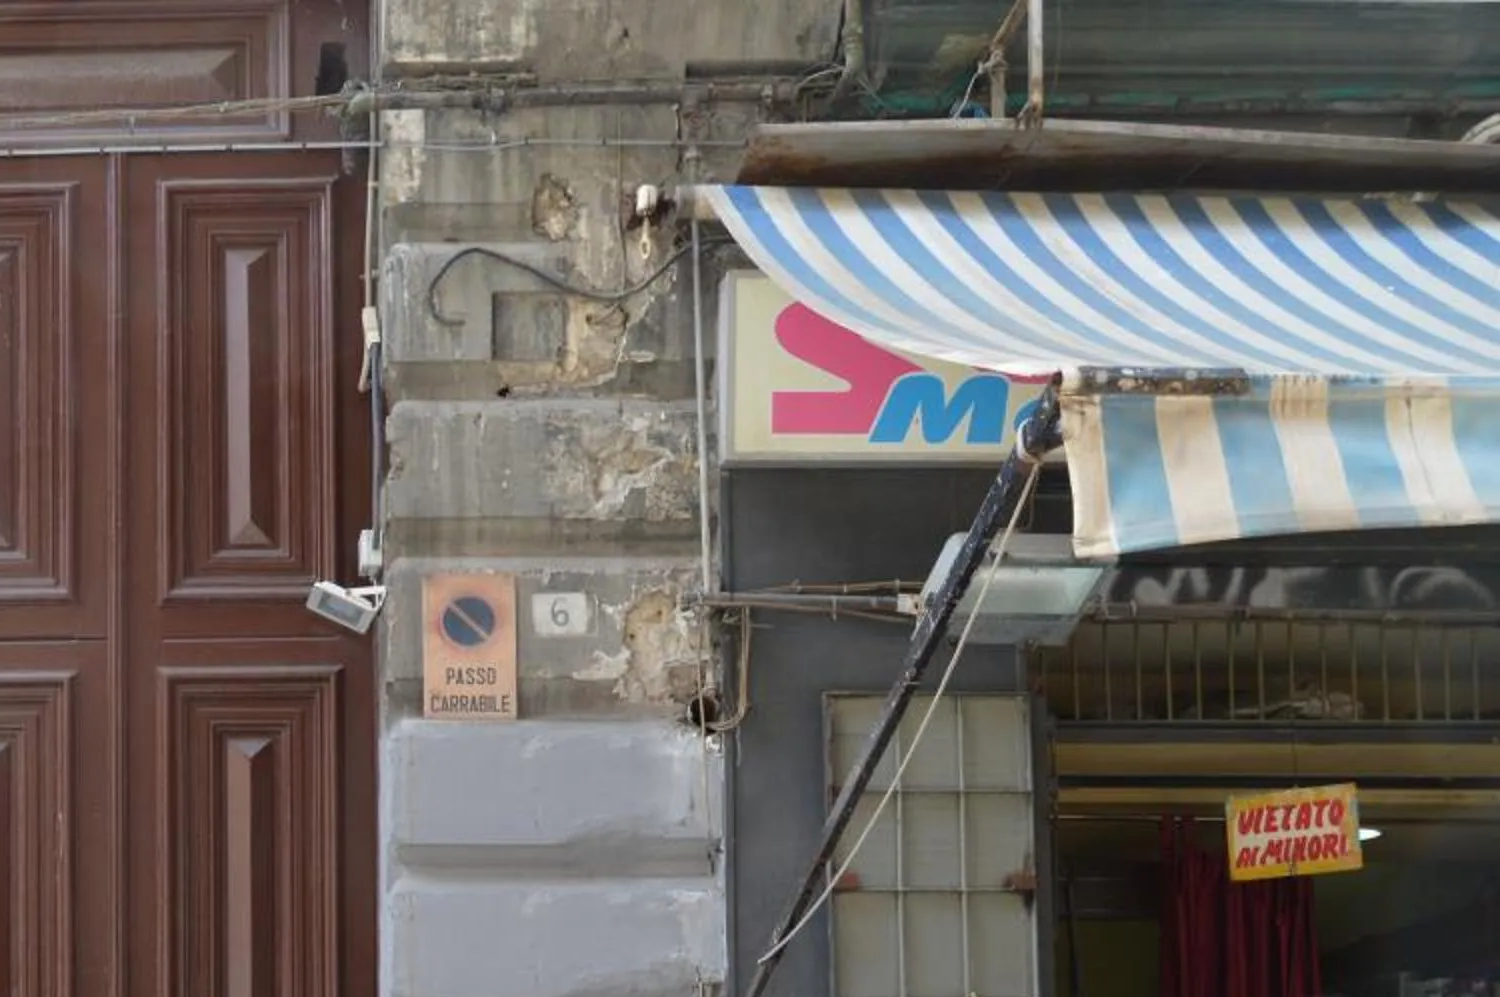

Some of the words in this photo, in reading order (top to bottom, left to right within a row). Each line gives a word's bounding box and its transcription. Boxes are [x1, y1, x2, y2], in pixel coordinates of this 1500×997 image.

[550, 597, 571, 628] 6
[445, 667, 498, 686] PASSO
[429, 694, 511, 714] CARRABILE
[1237, 799, 1345, 836] VIETATO
[1260, 833, 1349, 864] MINORI
